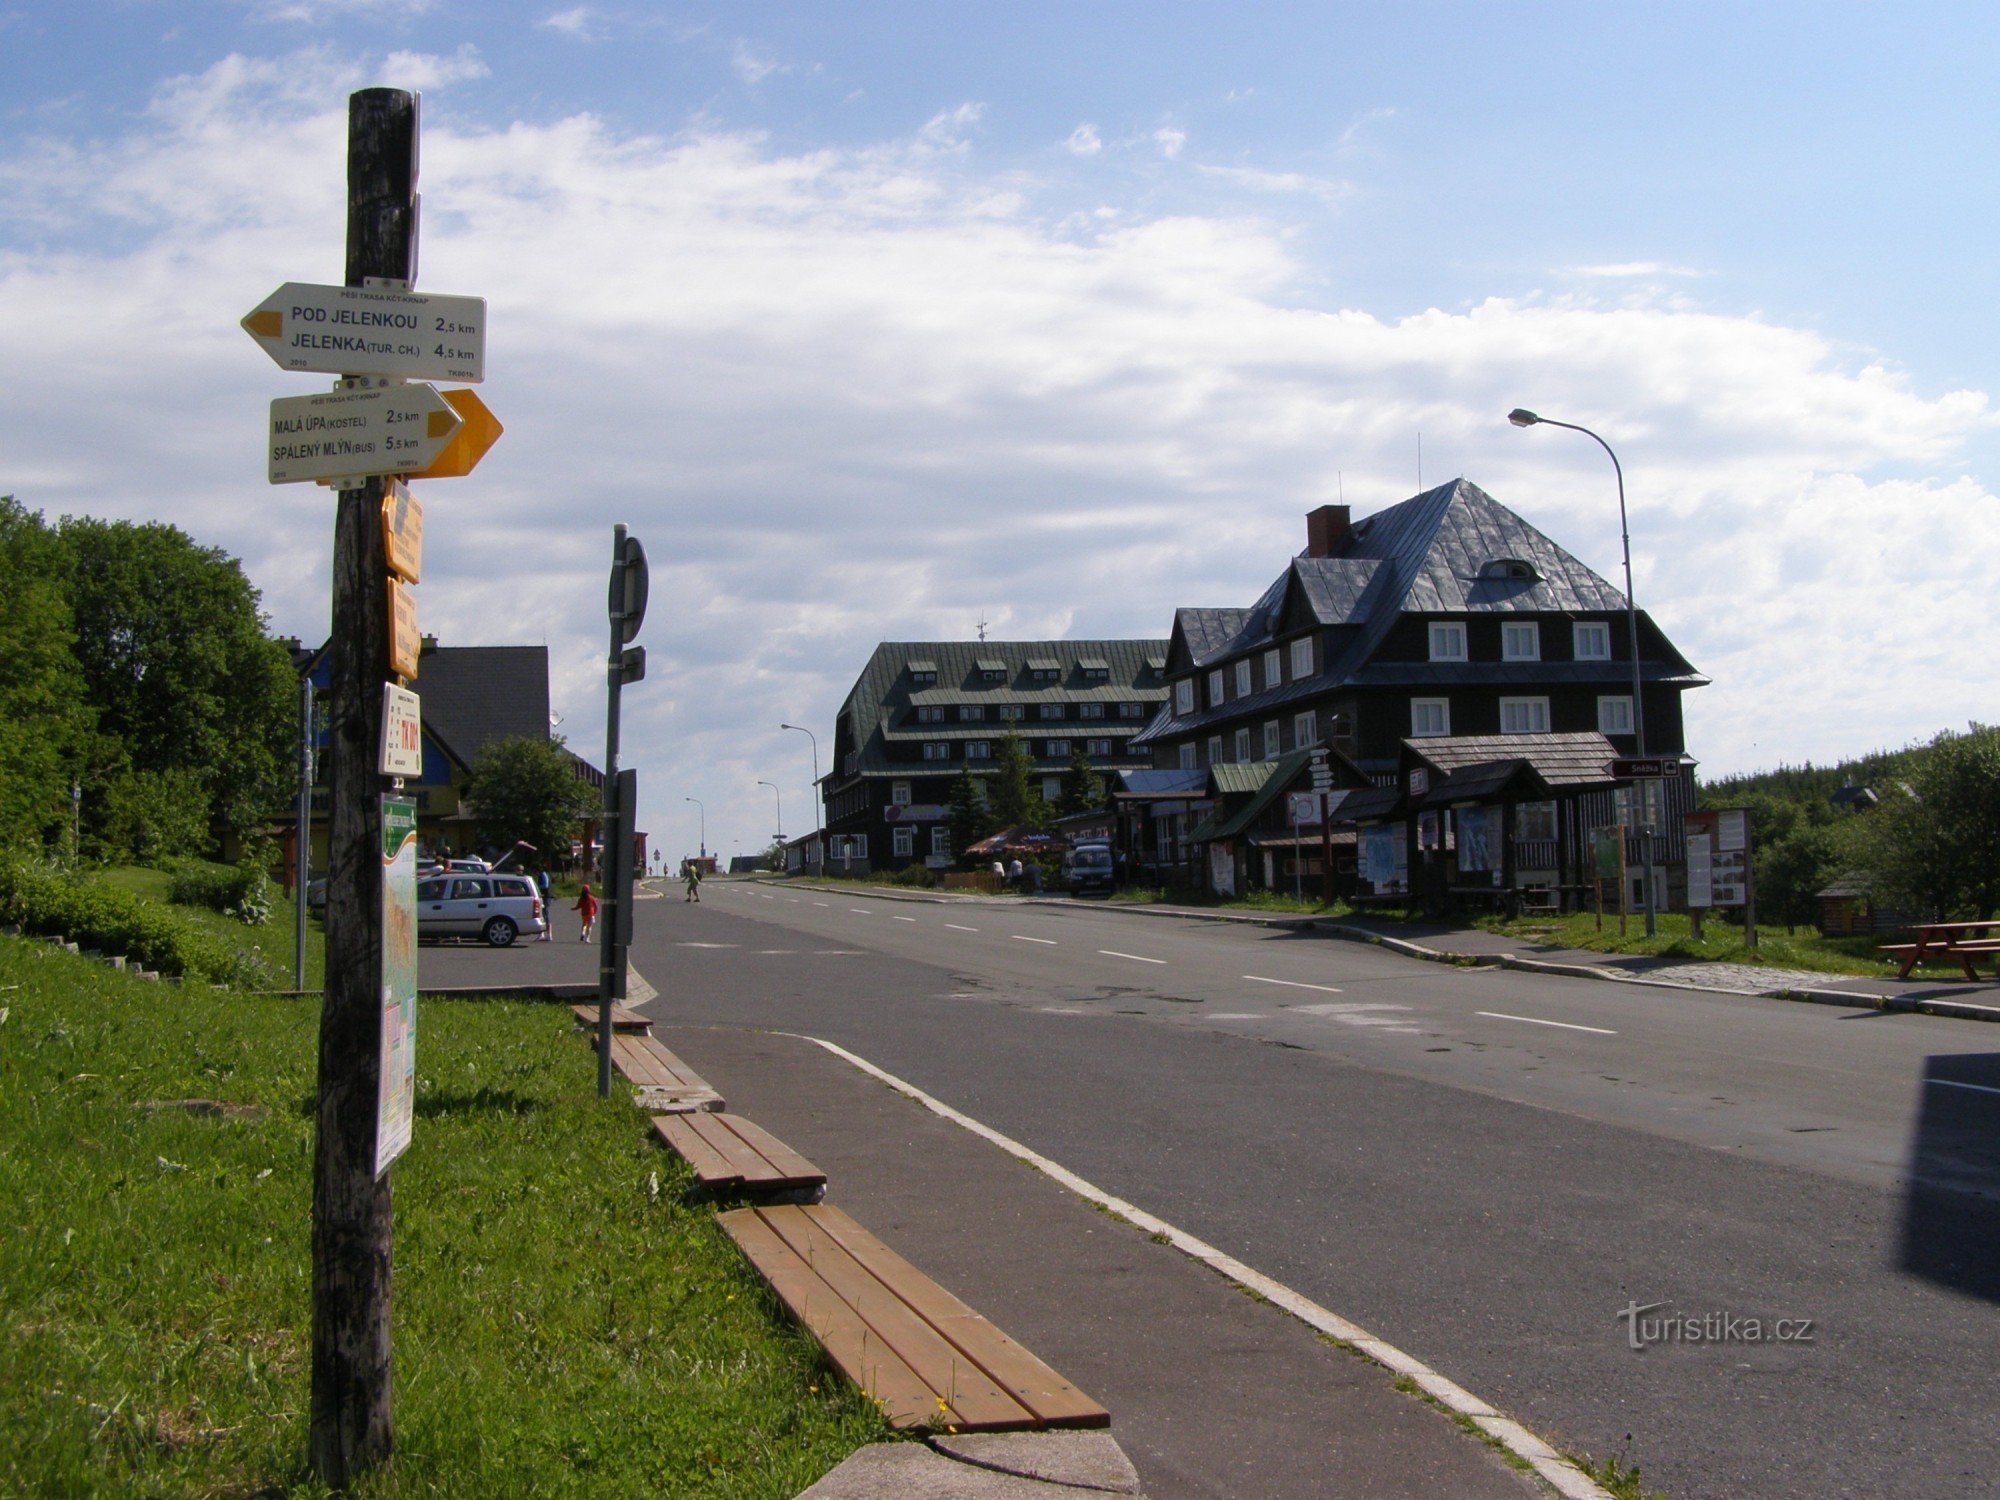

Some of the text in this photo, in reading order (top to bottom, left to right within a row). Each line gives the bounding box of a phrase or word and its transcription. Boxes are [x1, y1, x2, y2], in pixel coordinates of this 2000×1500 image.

[360, 293, 385, 301] TRASA
[292, 306, 475, 334] POD JELENKOU 2,5 km
[434, 344, 454, 359] 4,5
[457, 350, 475, 360] km
[274, 416, 303, 434] MALÁ
[386, 410, 403, 424] 2,5
[405, 412, 419, 421] km
[273, 442, 321, 461] SPÁLENÝ
[385, 436, 402, 450] 5,5
[404, 440, 419, 448] km
[402, 720, 409, 750] TK
